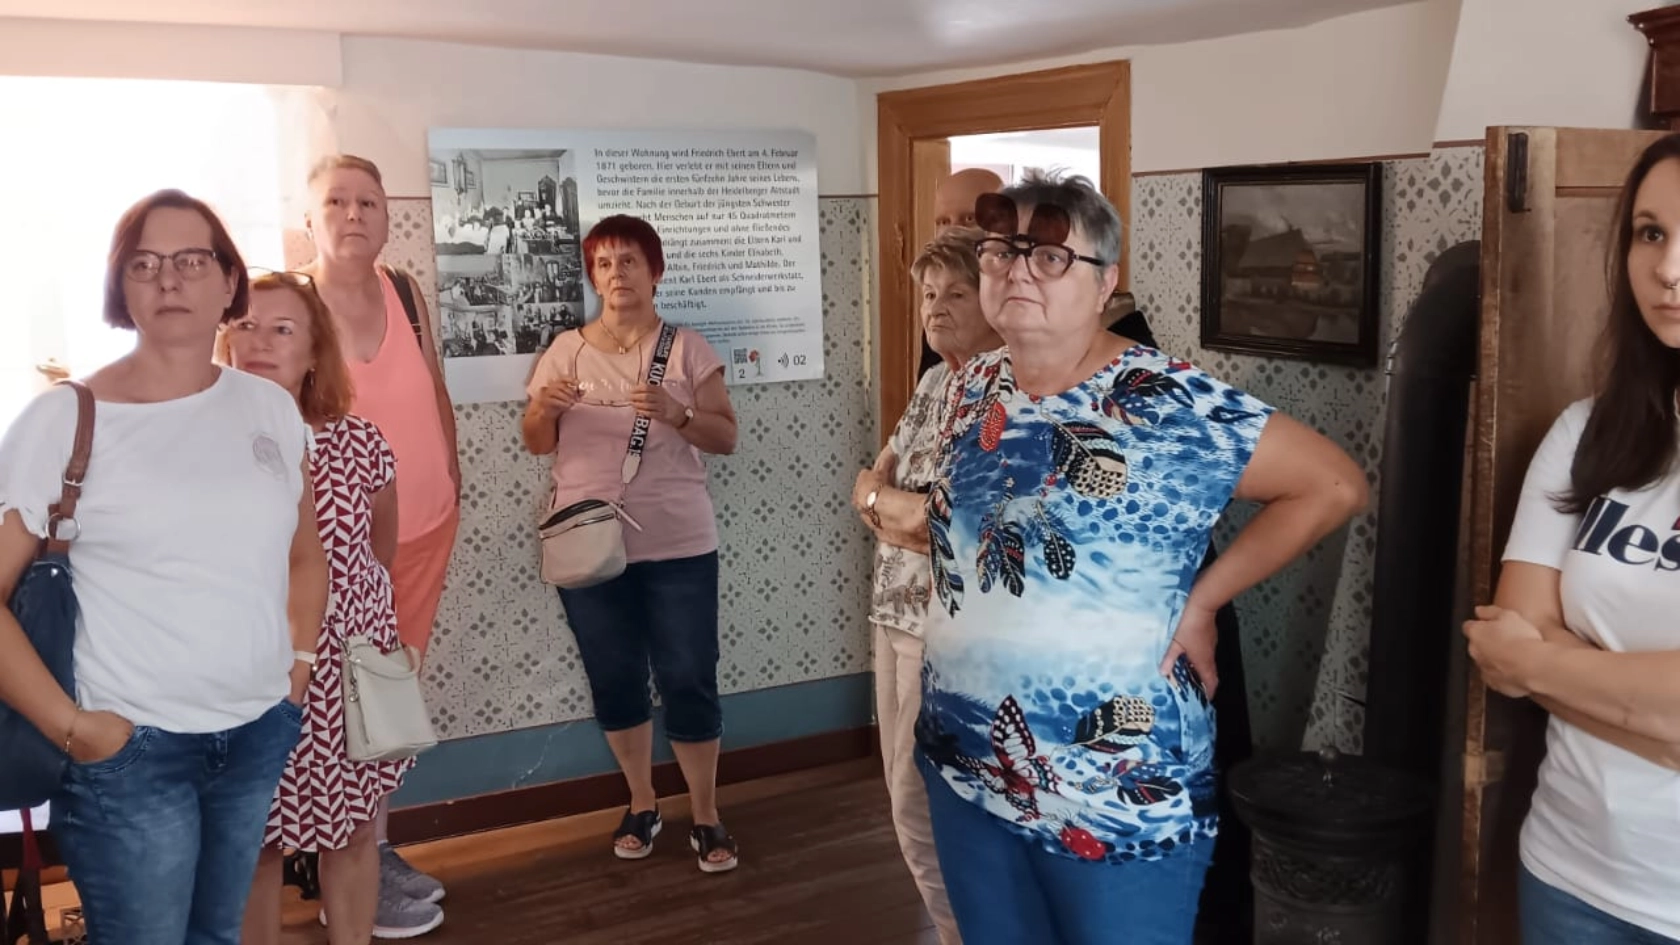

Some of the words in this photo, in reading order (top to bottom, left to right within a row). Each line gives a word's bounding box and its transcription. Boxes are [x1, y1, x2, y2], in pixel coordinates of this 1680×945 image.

[631, 148, 669, 160] Wohnung
[672, 148, 688, 157] wird
[692, 148, 724, 157] Friedrich
[726, 148, 746, 157] Ebert
[772, 148, 798, 157] Februar
[596, 162, 616, 170] 1871
[656, 162, 672, 170] Hier
[715, 162, 729, 170] mit
[757, 161, 780, 170] Eltern
[782, 161, 796, 170] und
[650, 174, 662, 183] die
[664, 174, 690, 182] ersten
[728, 173, 748, 182] Jahre
[597, 188, 620, 196] bevor
[622, 187, 634, 196] die
[636, 187, 666, 196] Familie
[668, 186, 704, 196] innerhalb
[707, 186, 719, 195] der
[722, 186, 768, 196] Heidelberger
[636, 200, 657, 209] Nach
[660, 200, 672, 209] der
[674, 200, 700, 209] Geburt
[703, 200, 716, 208] der
[654, 212, 694, 221] Menschen
[696, 212, 708, 220] auf
[712, 212, 726, 220] nur
[714, 224, 729, 232] und
[731, 224, 750, 232] ohne
[734, 236, 746, 245] die
[772, 235, 786, 244] Karl
[788, 234, 802, 243] und
[666, 250, 682, 260] und
[684, 250, 696, 259] die
[722, 248, 746, 258] Kinder
[692, 261, 726, 271] Friedrich
[728, 260, 744, 270] und
[783, 258, 796, 268] Der
[680, 274, 696, 284] Karl
[697, 274, 716, 283] Ebert
[718, 273, 730, 282] als
[688, 286, 718, 296] Kunden
[718, 284, 756, 296] empfängt
[758, 284, 772, 294] und
[774, 284, 785, 292] bis
[793, 355, 806, 366] 02
[738, 369, 746, 379] 2
